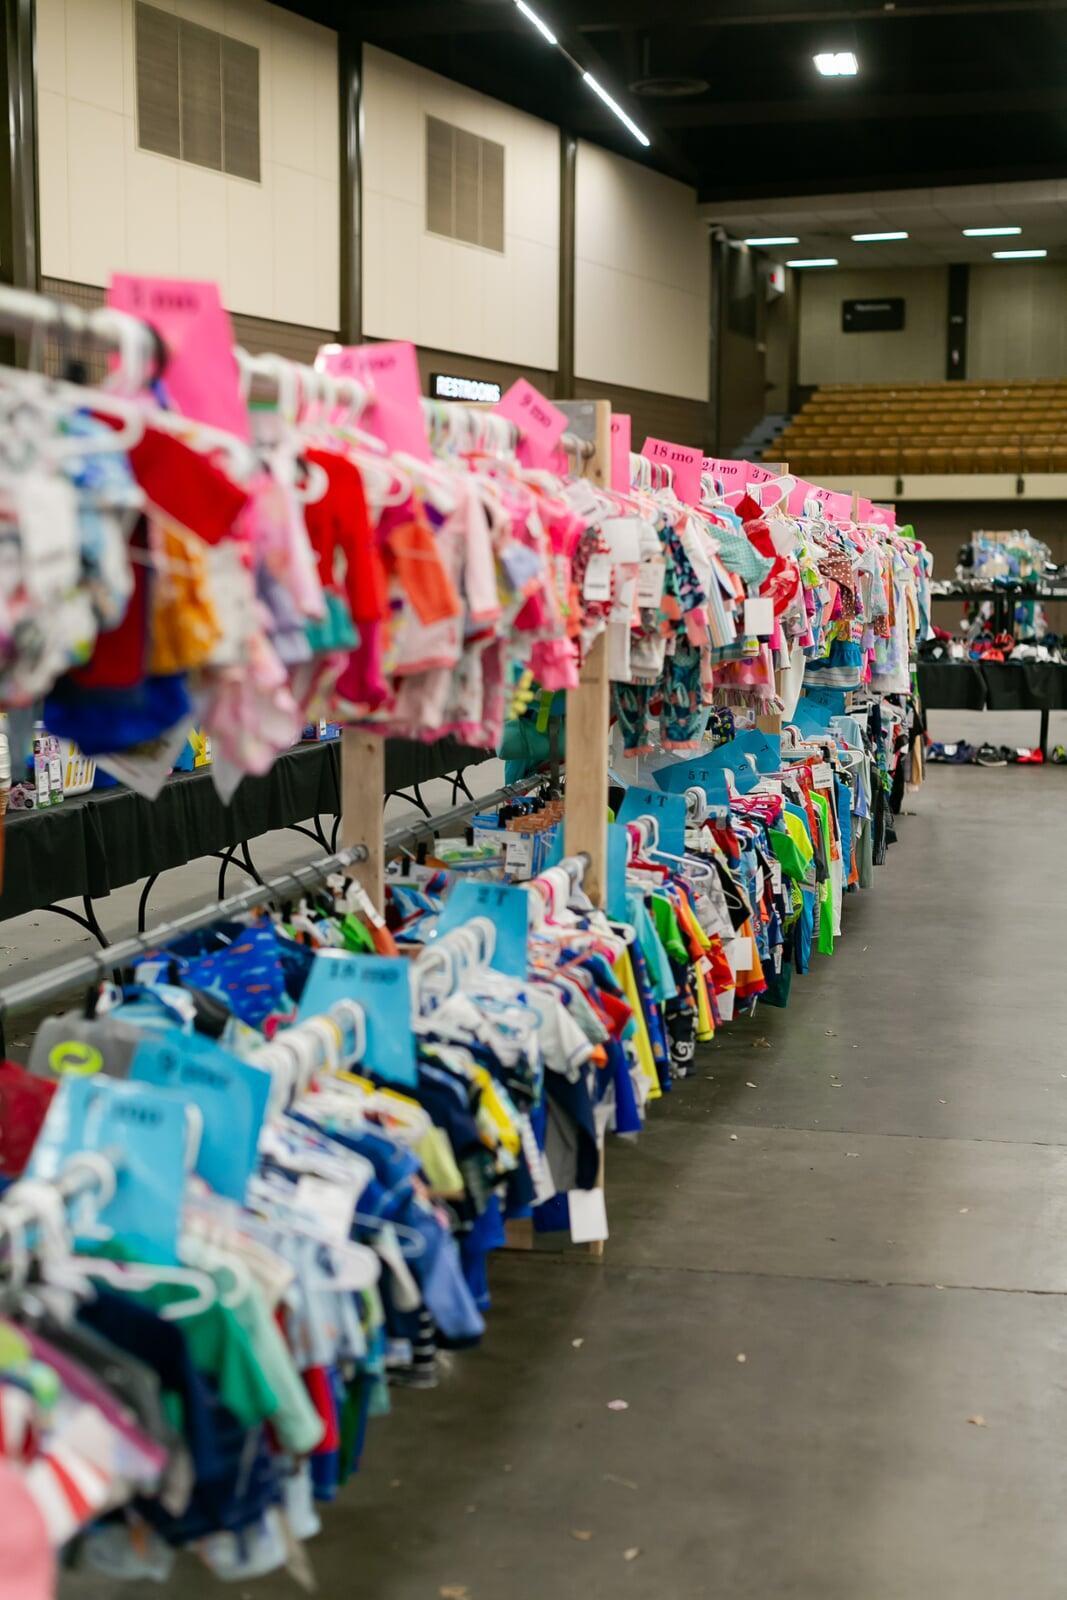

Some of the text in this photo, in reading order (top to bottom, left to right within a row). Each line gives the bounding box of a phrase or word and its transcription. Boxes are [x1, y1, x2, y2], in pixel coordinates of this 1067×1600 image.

[529, 404, 553, 430] mo
[653, 444, 695, 464] 18 mo
[701, 461, 738, 476] 24 mo
[752, 468, 772, 483] 3 T
[816, 490, 832, 501] 5 T
[687, 770, 710, 781] 5 T
[644, 794, 669, 808] 4 T
[494, 887, 510, 908] T
